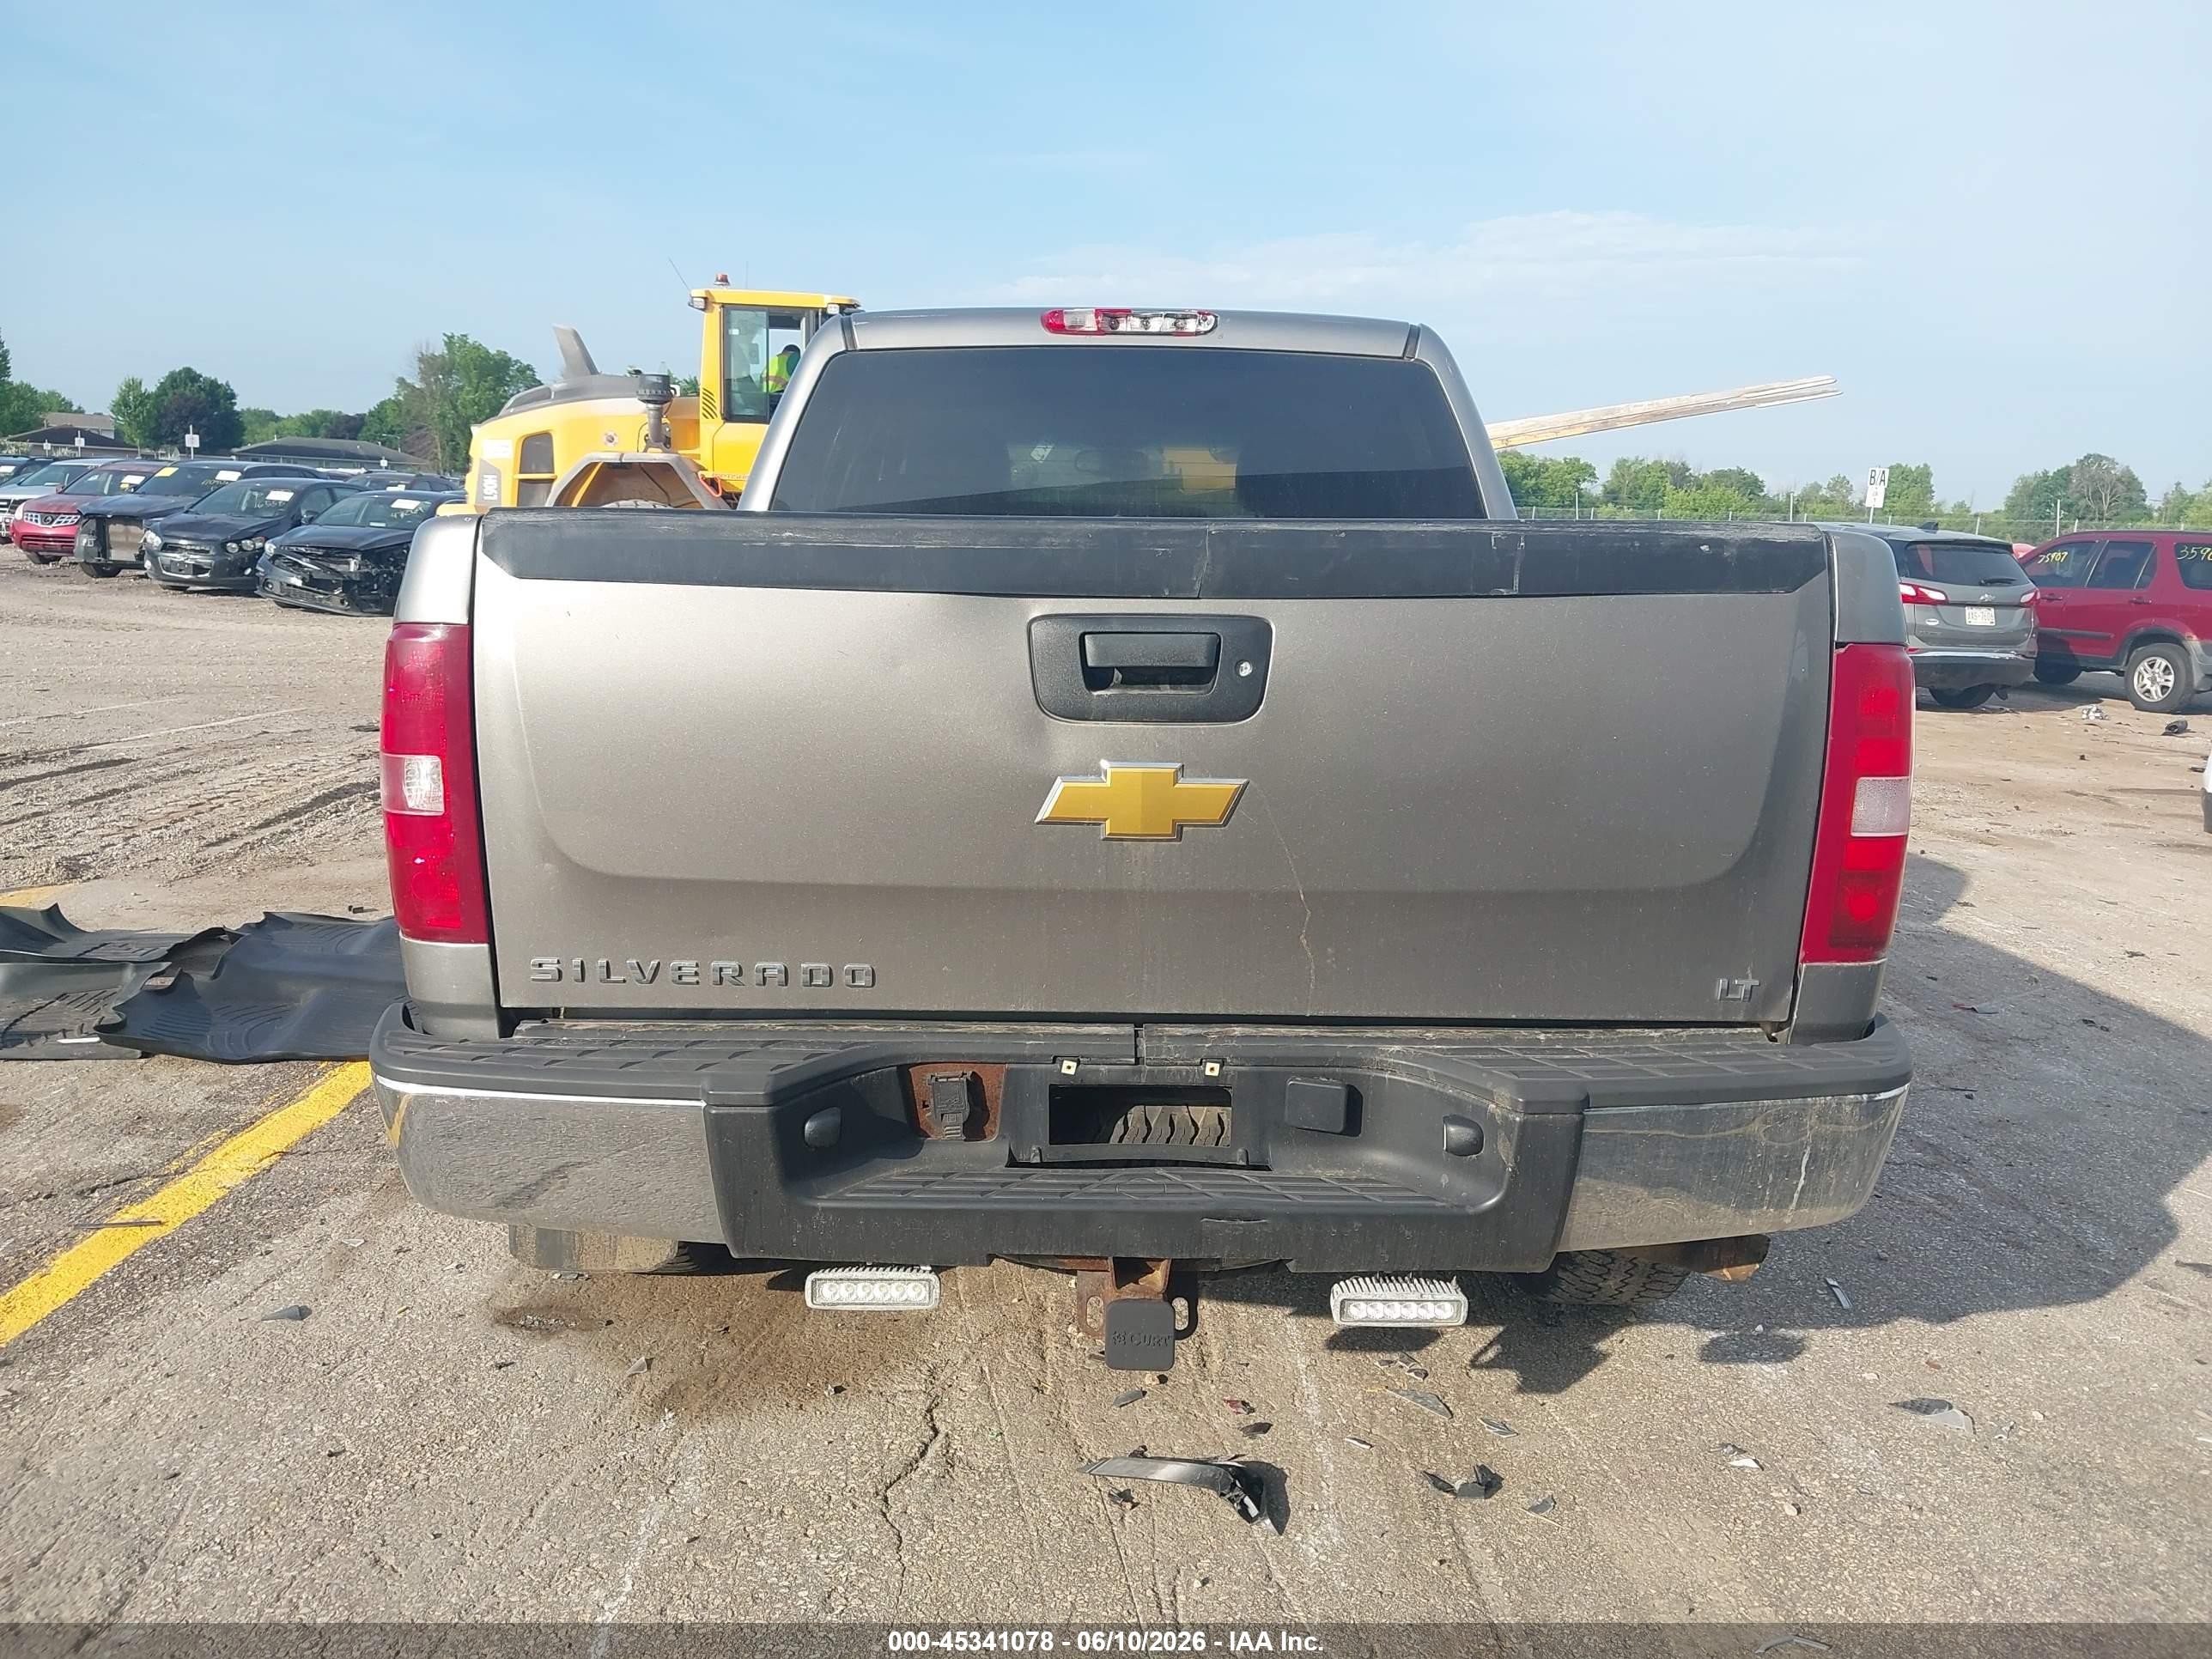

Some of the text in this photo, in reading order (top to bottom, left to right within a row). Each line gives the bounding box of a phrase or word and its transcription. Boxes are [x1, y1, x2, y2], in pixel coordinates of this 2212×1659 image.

[1869, 469, 1886, 486] B/A
[530, 957, 878, 990] SILVERADO
[1717, 978, 1760, 1003] LT
